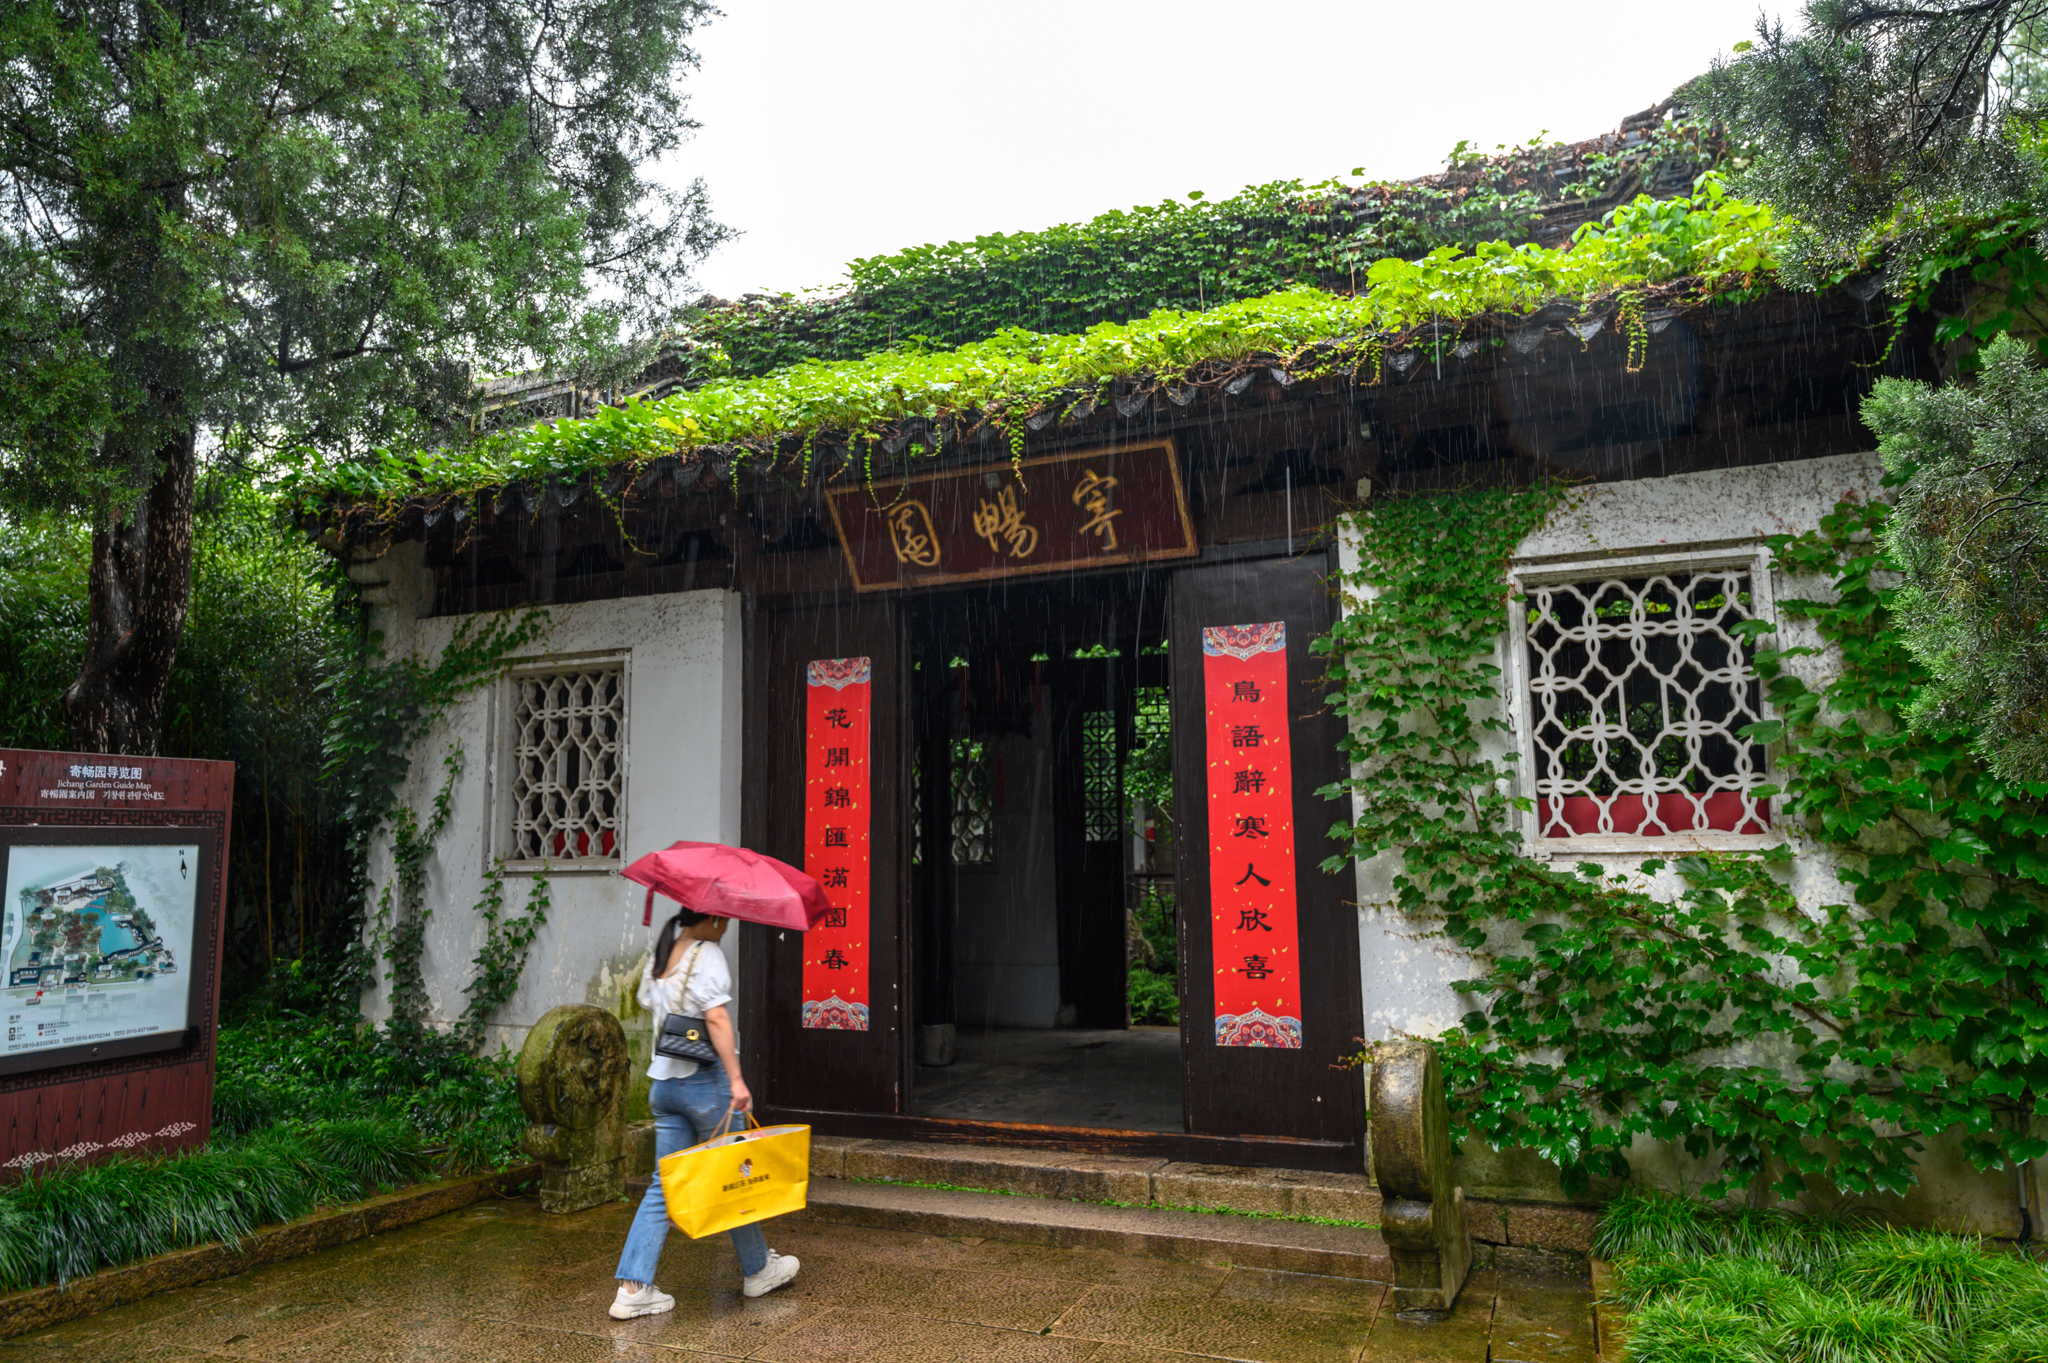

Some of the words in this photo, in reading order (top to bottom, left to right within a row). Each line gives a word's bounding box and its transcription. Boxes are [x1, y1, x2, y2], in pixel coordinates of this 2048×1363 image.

[57, 779, 84, 790] Jichang
[85, 780, 112, 789] Garden
[113, 781, 135, 790] Guide
[135, 782, 152, 792] Map
[70, 764, 142, 780] 寄畅园导览图
[820, 707, 852, 971] 花開錦匯滿園春
[1230, 679, 1275, 981] 鳥語辭寒人欣喜
